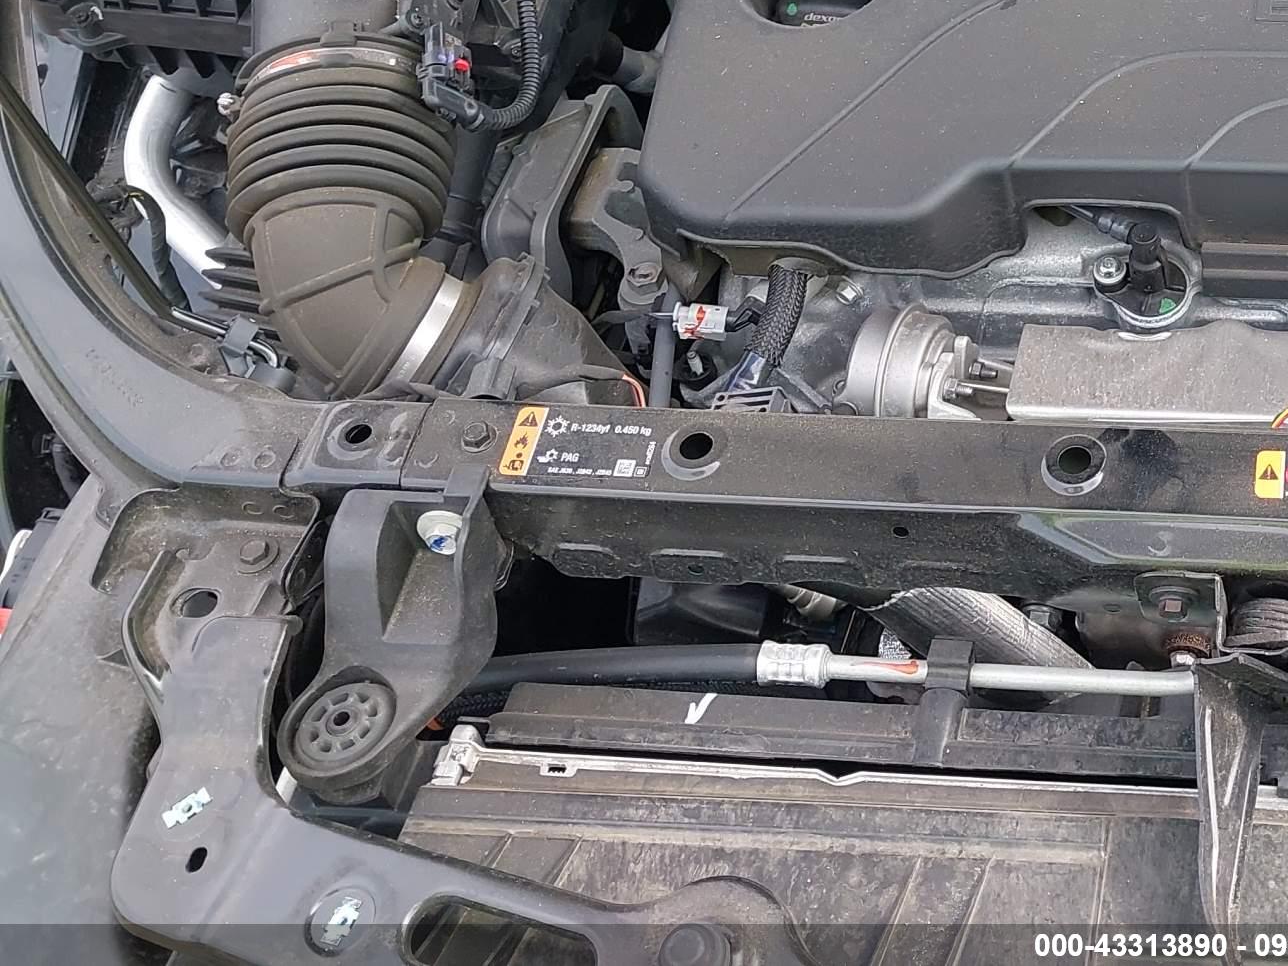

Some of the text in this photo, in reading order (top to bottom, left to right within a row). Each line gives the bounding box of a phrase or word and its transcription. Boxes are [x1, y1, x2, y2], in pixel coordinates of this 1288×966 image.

[570, 423, 652, 436] R-1234yf 0.450 kg
[560, 452, 580, 462] PAG
